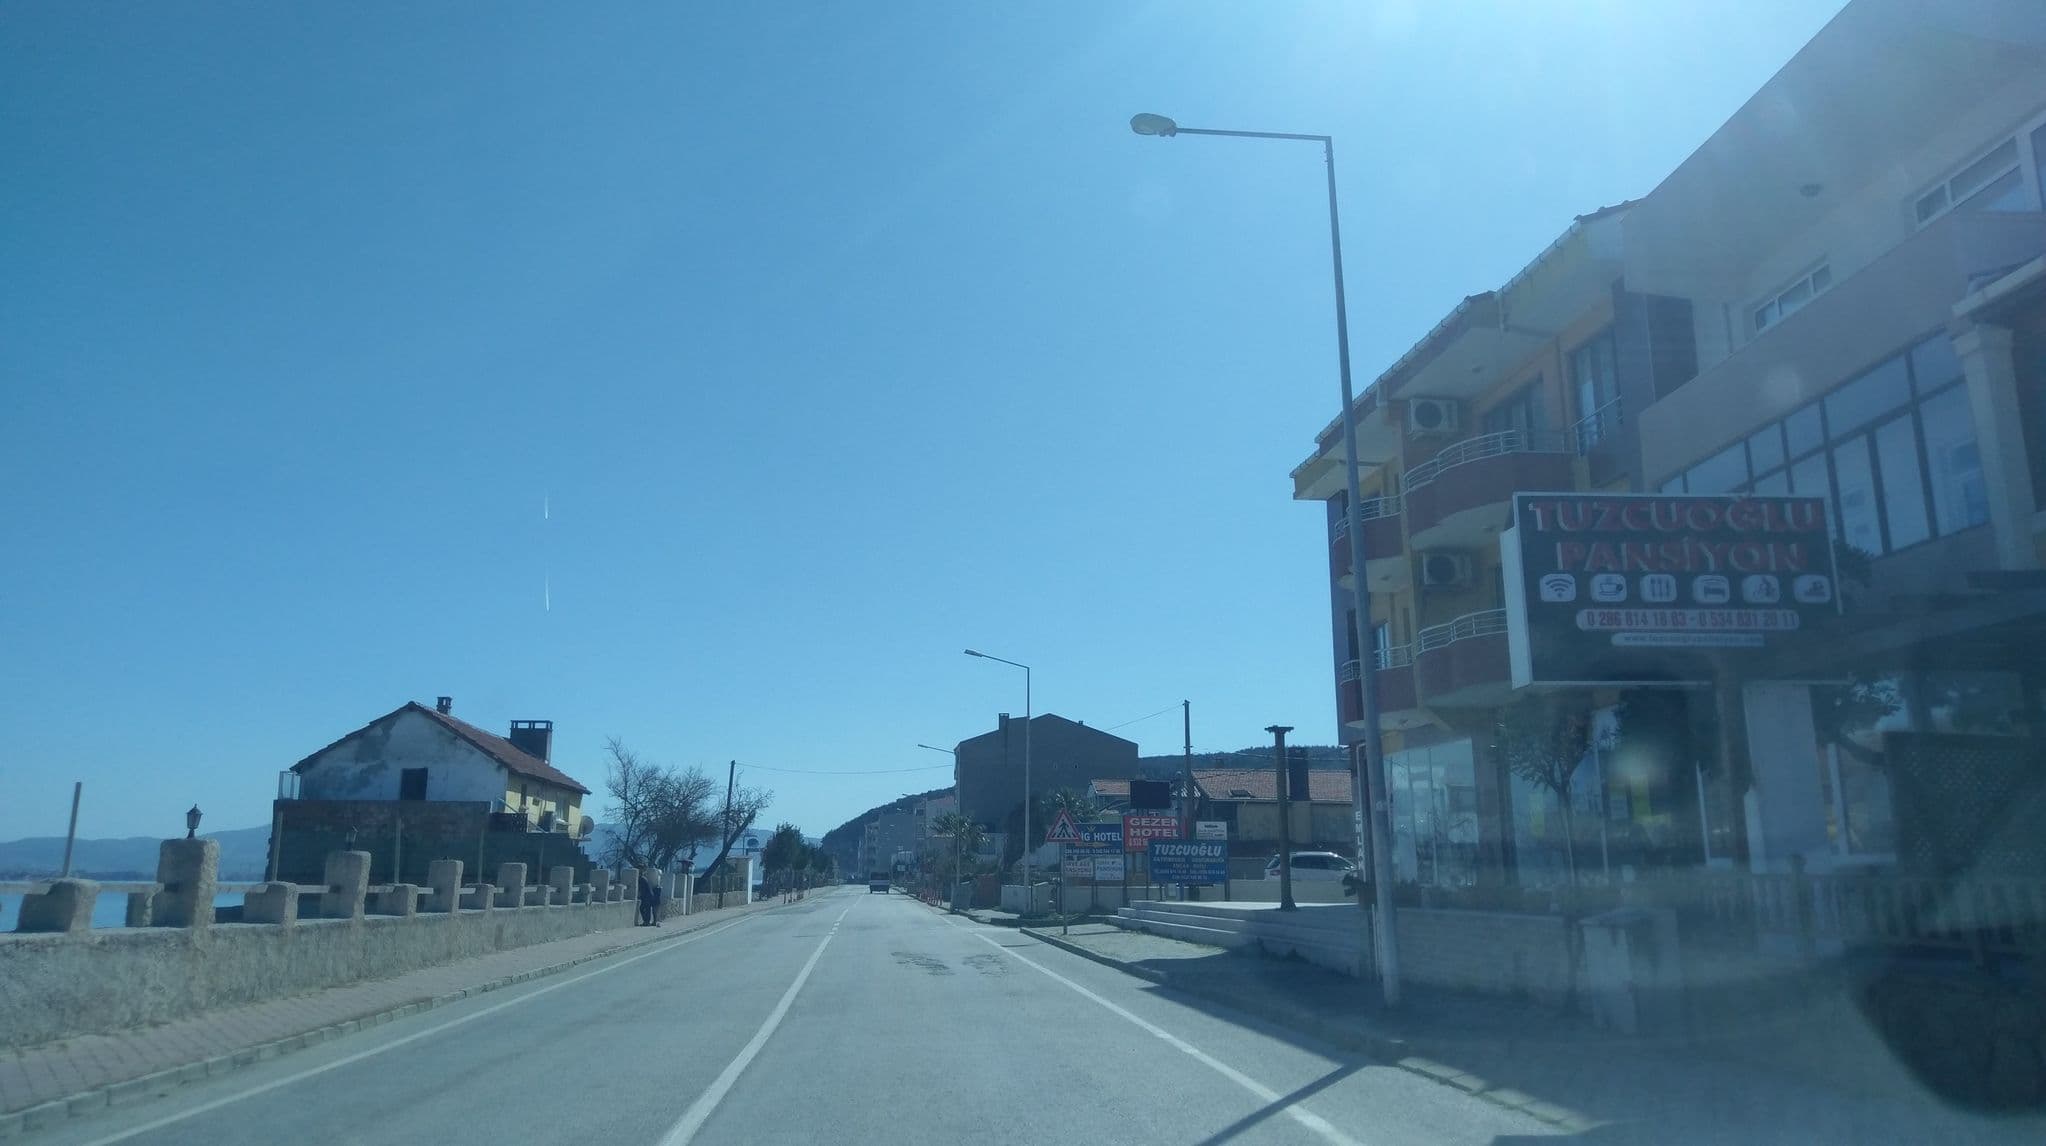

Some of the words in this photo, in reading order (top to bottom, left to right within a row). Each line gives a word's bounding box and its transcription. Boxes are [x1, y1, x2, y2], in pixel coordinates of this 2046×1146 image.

[1555, 537, 1808, 572] PANSİYON
[1586, 610, 1595, 626] 0
[1600, 610, 1622, 626] 286
[1094, 832, 1122, 842] HOTEL
[1130, 828, 1179, 838] HOTEL
[1154, 843, 1222, 857] TUZCUOĞLU
